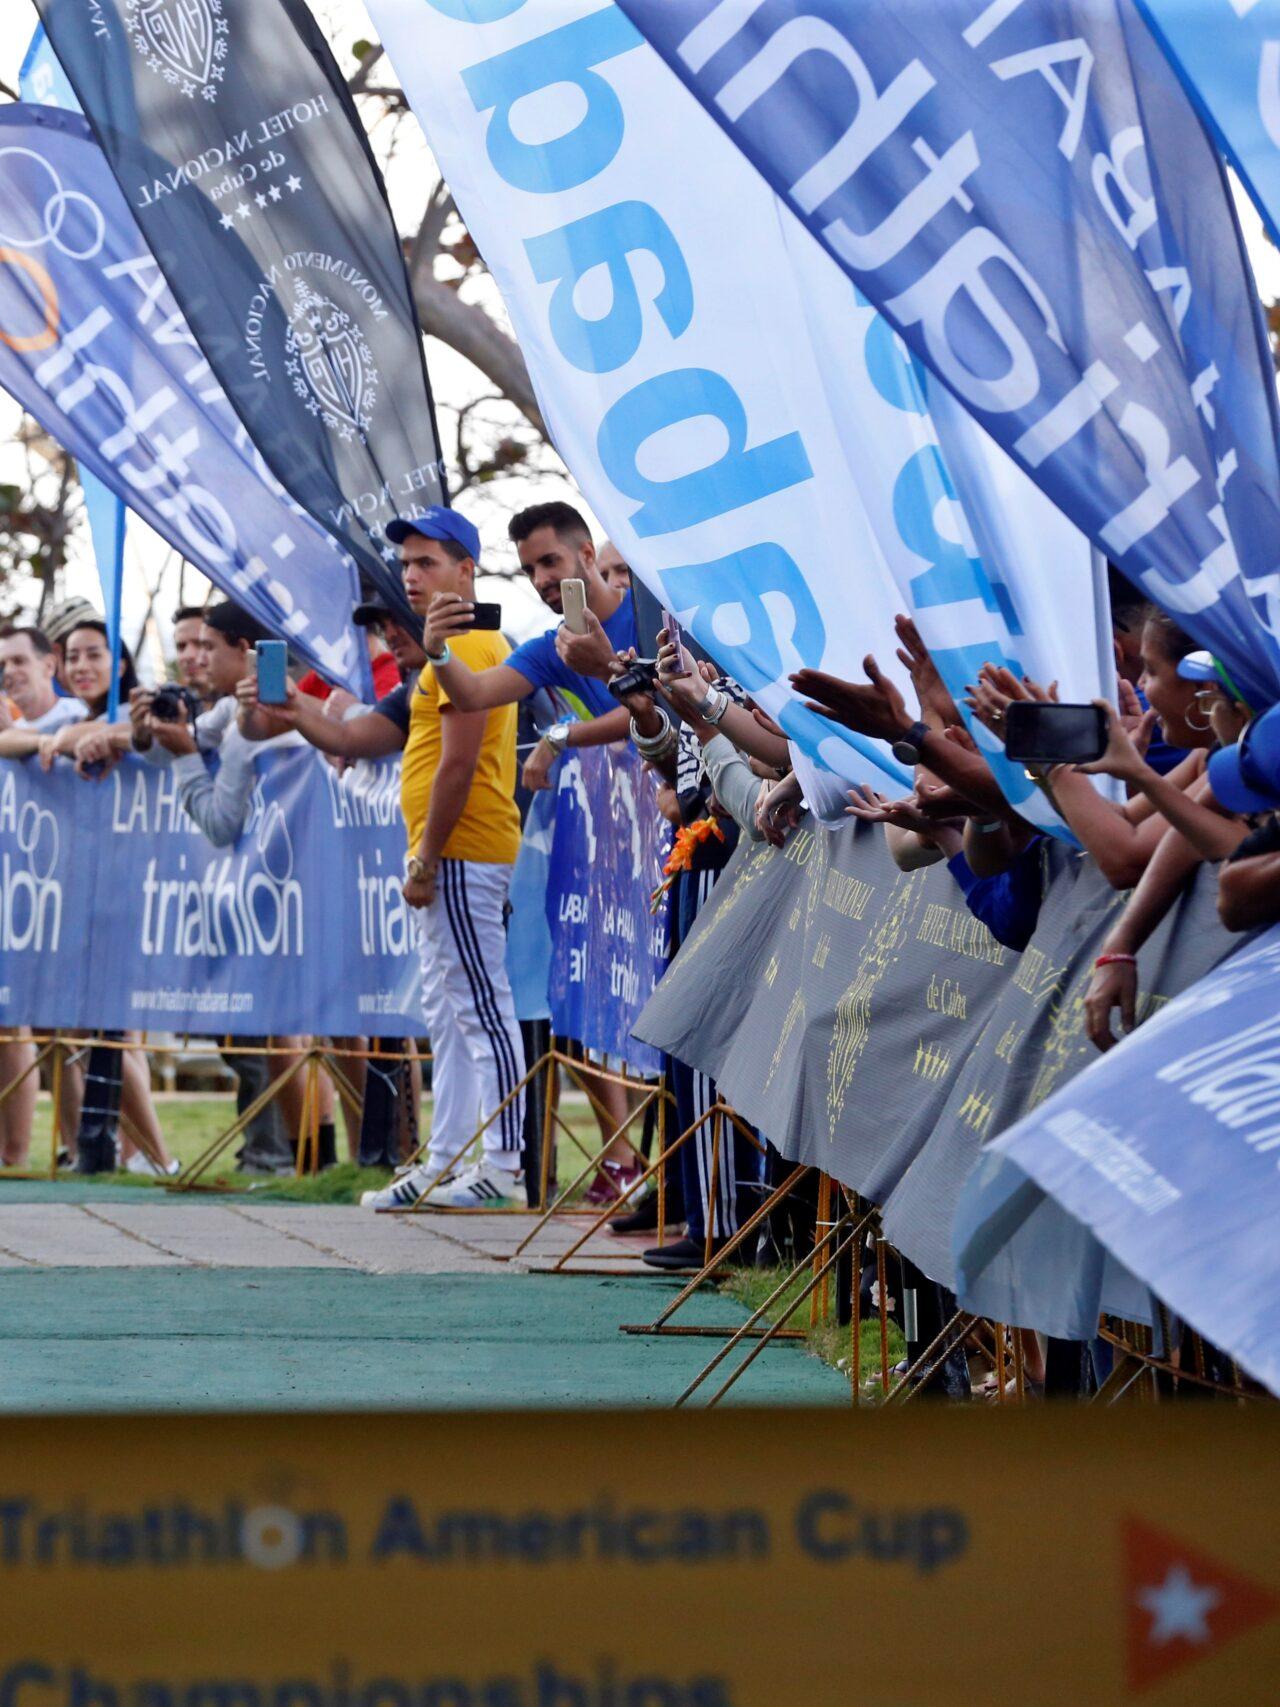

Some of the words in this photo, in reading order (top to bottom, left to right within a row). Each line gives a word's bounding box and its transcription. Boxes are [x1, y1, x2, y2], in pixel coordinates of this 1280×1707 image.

[112, 769, 148, 833] LA
[141, 854, 303, 957] triathlon
[374, 1494, 770, 1562] American
[798, 1490, 968, 1571] Cup
